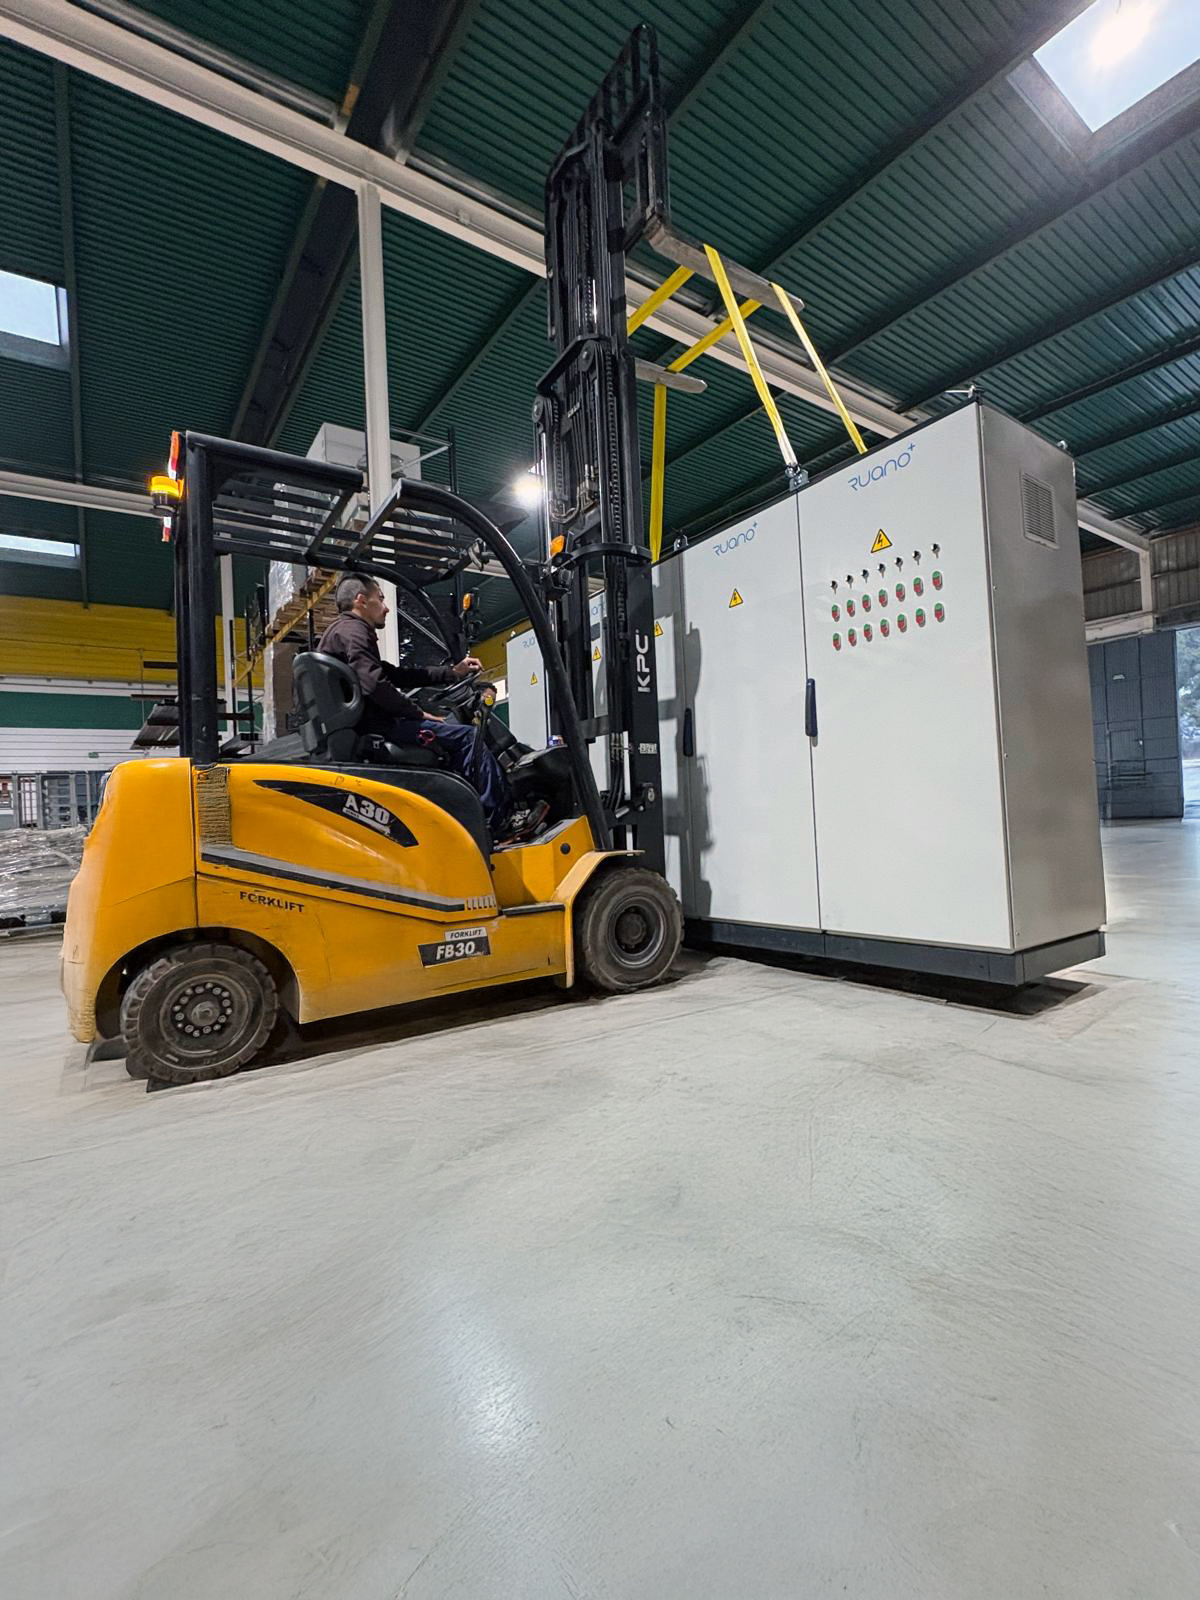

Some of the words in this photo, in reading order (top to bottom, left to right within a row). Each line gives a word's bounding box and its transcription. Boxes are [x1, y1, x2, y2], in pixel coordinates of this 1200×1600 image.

[635, 634, 650, 693] KPC
[345, 794, 390, 825] A30
[240, 891, 305, 912] FORKLIFT
[450, 929, 482, 939] FORKLIFT
[436, 941, 476, 961] FB30
